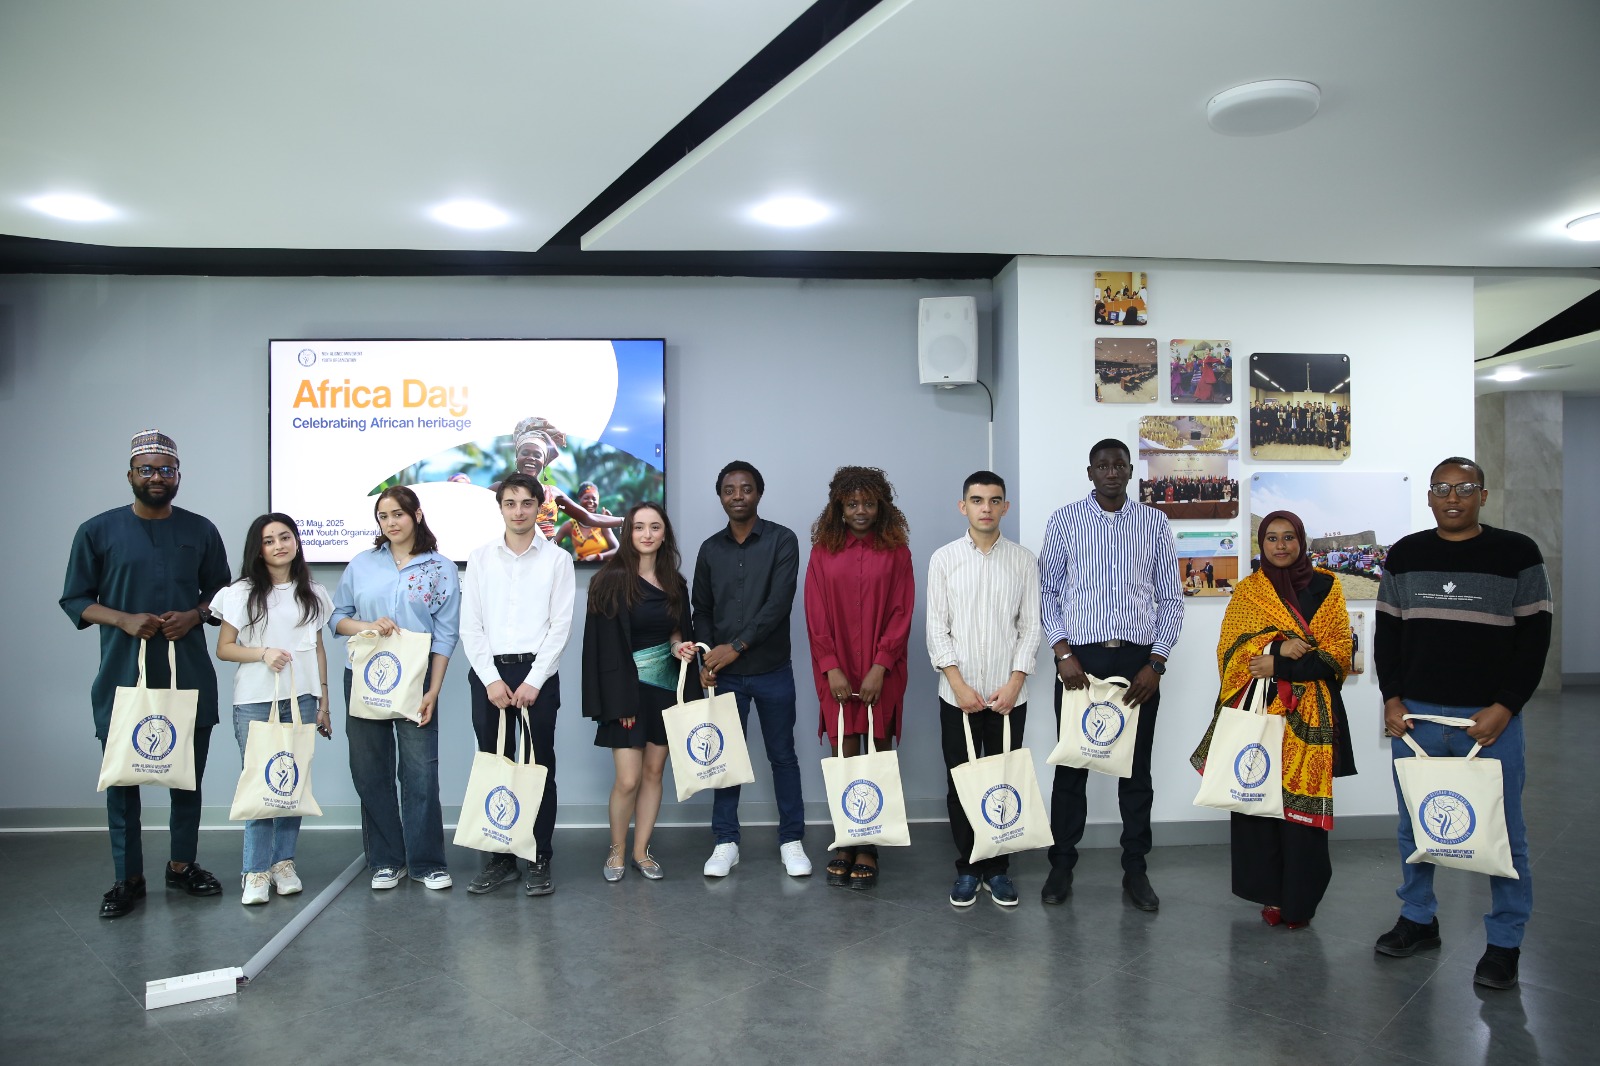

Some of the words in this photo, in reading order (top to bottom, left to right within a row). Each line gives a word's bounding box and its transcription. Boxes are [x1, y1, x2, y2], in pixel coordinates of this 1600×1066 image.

[292, 378, 391, 408] Africa
[403, 379, 469, 417] Day
[292, 417, 367, 431] Celebrating
[370, 417, 414, 428] African
[417, 417, 472, 431] heritage
[296, 519, 305, 527] 23
[325, 519, 345, 527] 2025
[316, 529, 339, 537] Youth
[340, 529, 382, 539] Organizati
[300, 539, 349, 548] eadquarters
